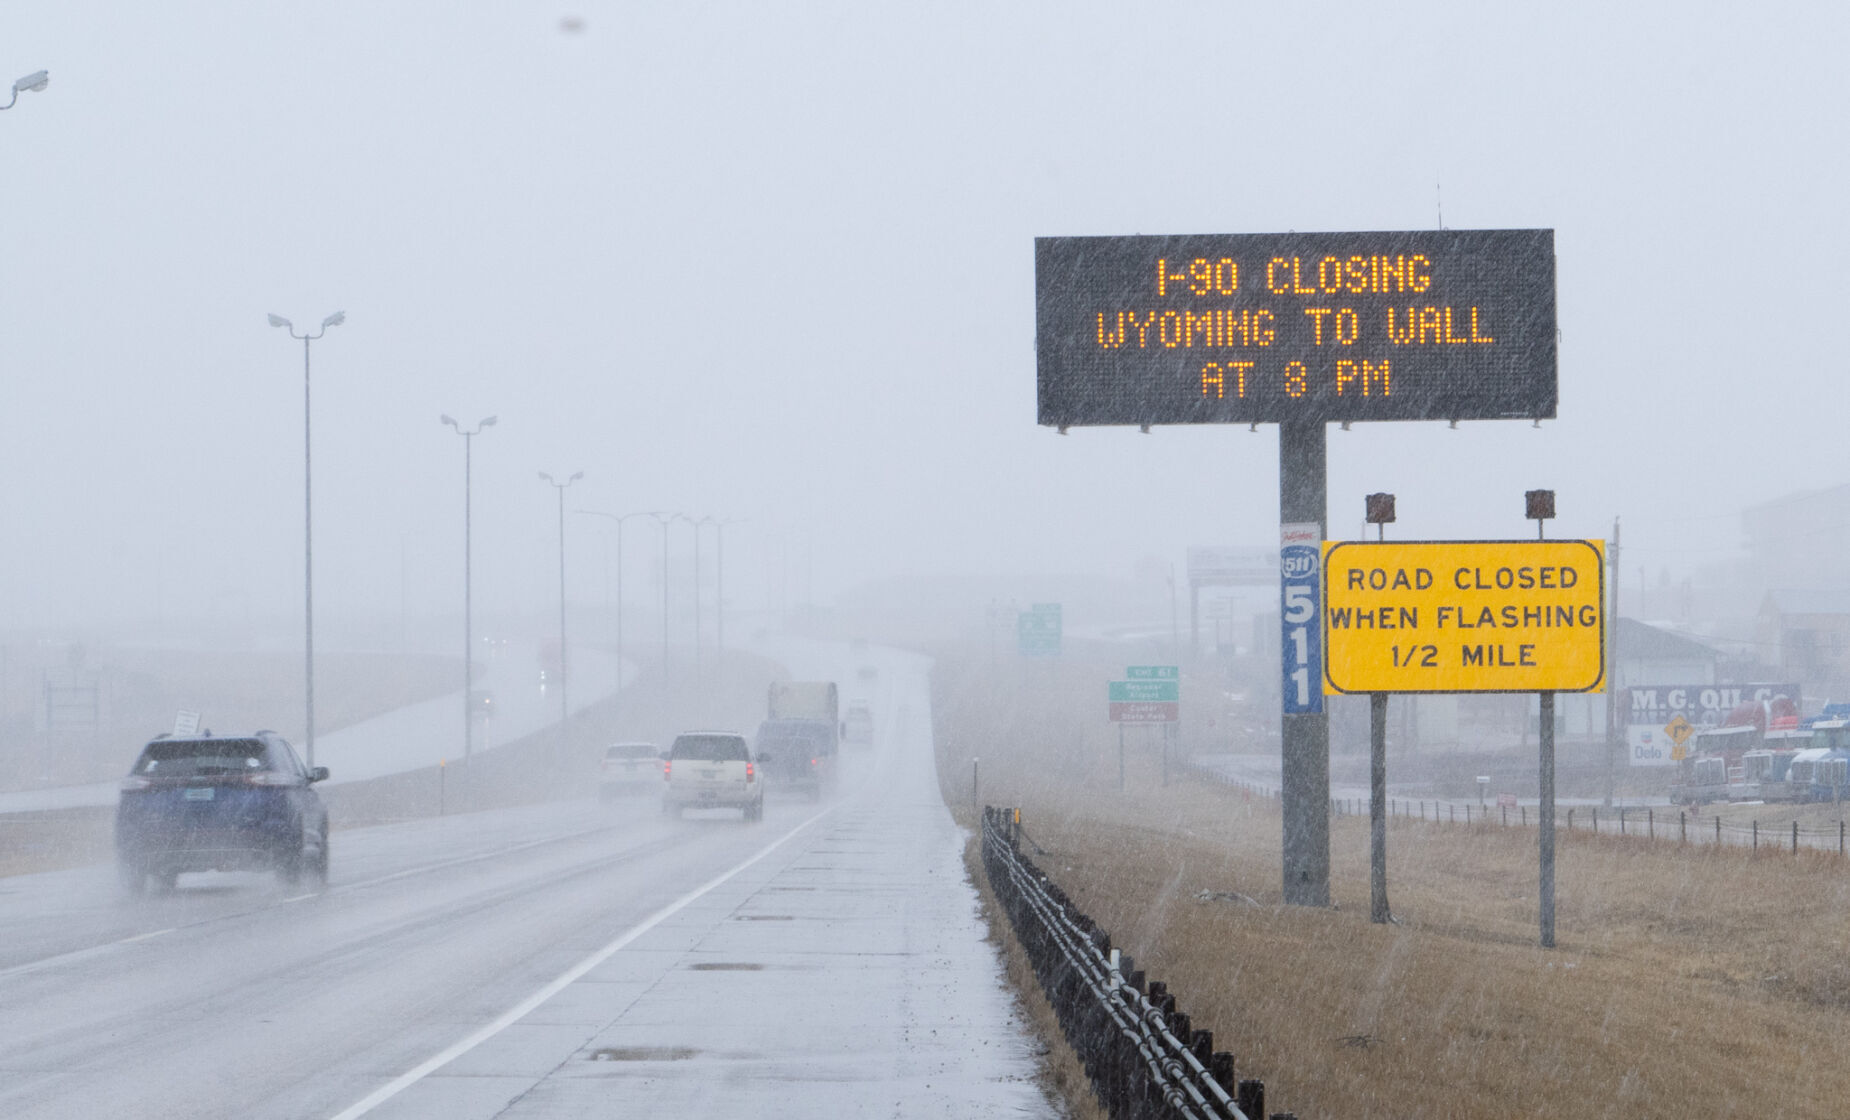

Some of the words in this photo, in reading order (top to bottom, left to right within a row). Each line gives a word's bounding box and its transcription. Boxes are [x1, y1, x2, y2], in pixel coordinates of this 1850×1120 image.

[1157, 257, 1238, 296] I-90
[1267, 254, 1430, 294] CLOSING
[1097, 309, 1275, 348] WYOMING
[1304, 308, 1358, 346] TO
[1387, 306, 1493, 344] WALL
[1202, 361, 1254, 398] AT
[1284, 361, 1306, 397] 8
[1336, 360, 1390, 396] PM
[1285, 556, 1310, 572] 511
[1348, 569, 1433, 590] ROAD
[1454, 567, 1578, 589] CLOSED
[1330, 607, 1418, 629] WHEN
[1437, 605, 1596, 628] FLASHING
[1391, 645, 1438, 667] 1/2
[1462, 645, 1537, 667] MILE
[1631, 688, 1696, 710] M.G.
[1635, 745, 1662, 759] Delo
